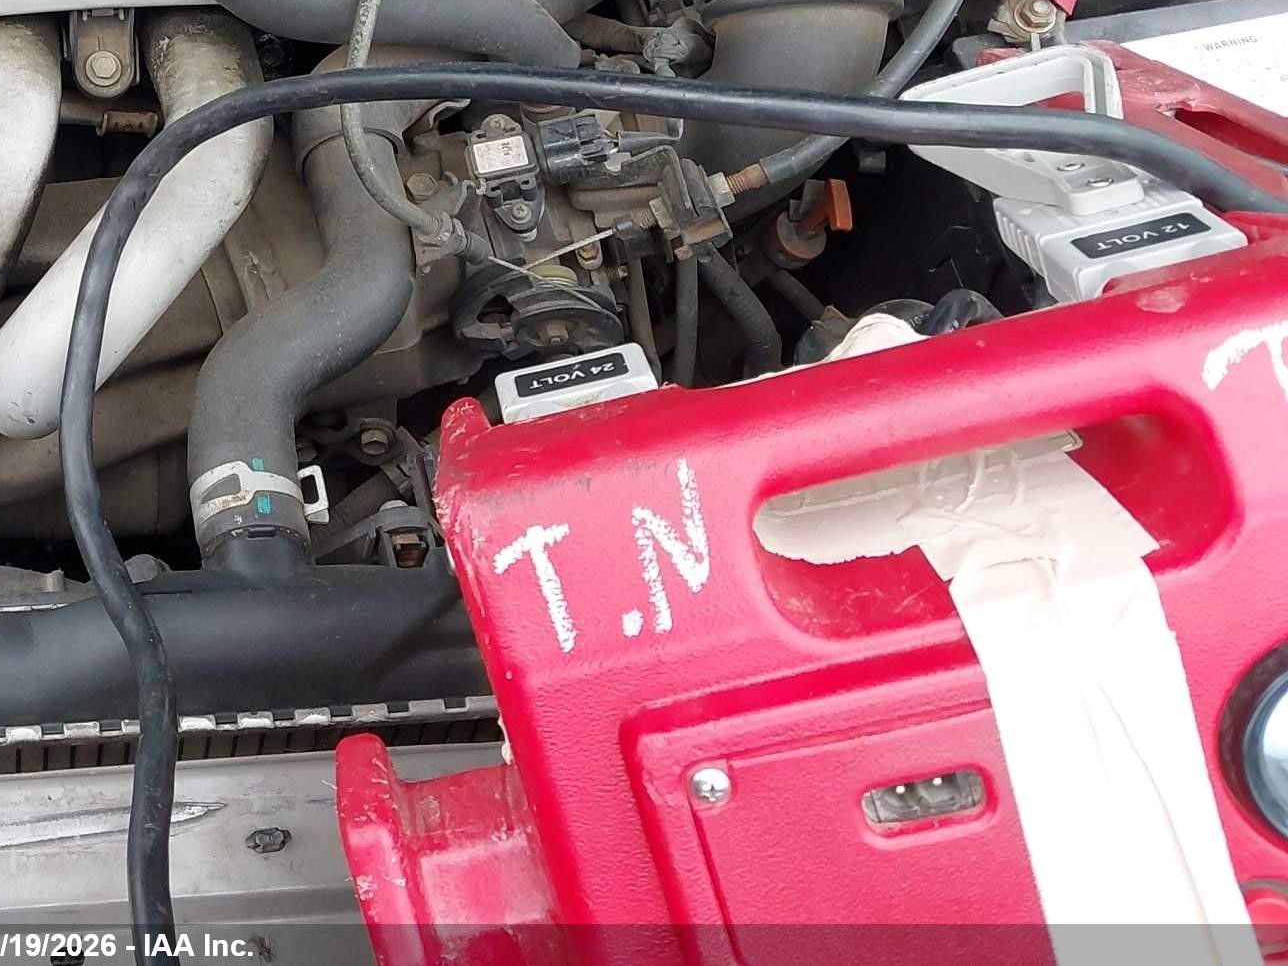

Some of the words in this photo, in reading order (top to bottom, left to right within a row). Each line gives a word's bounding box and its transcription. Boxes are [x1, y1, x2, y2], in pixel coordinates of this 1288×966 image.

[1202, 35, 1259, 51] WARNING
[1161, 221, 1190, 233] 12
[1097, 231, 1159, 251] VOLT
[590, 362, 615, 375] 24
[529, 370, 586, 390] VOLT
